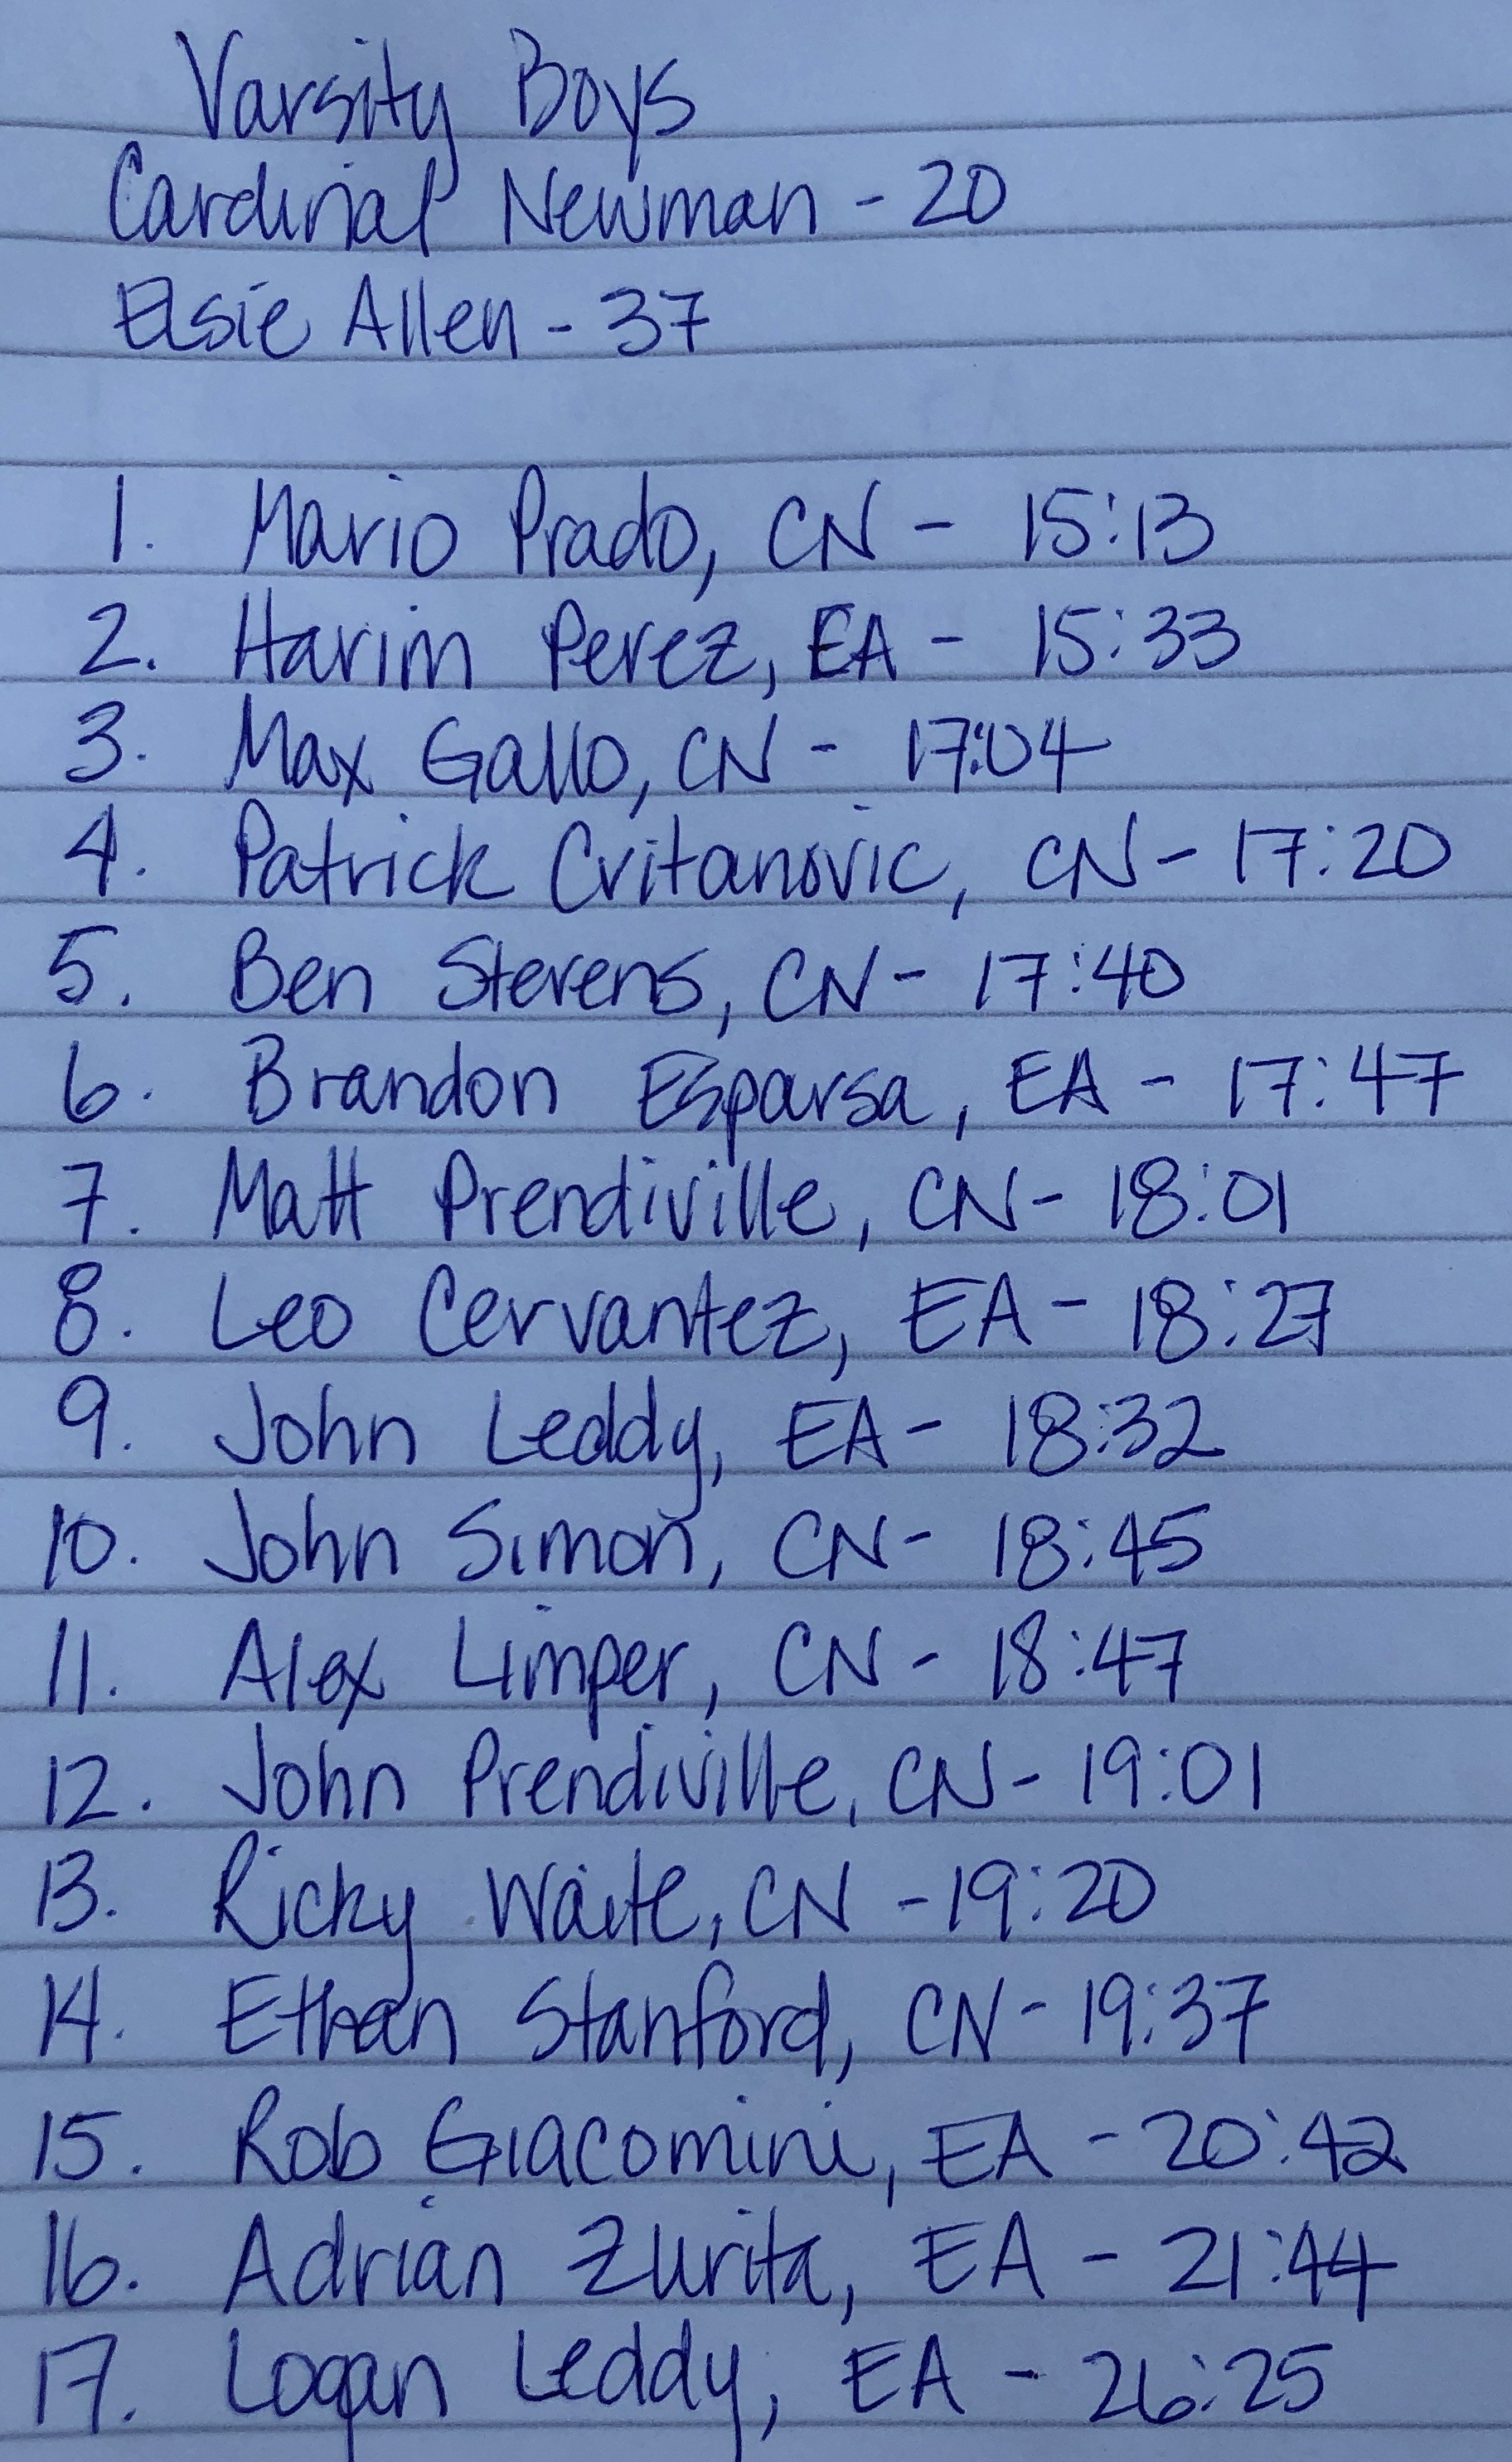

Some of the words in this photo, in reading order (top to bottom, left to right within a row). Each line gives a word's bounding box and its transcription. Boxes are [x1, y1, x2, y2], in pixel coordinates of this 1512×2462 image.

[176, 30, 458, 201] Varsity
[511, 27, 695, 180] Boys
[109, 141, 458, 258] Cardinal
[504, 168, 817, 245] Newman
[913, 160, 1006, 226] 20
[114, 277, 310, 360] Elsie
[344, 274, 517, 360] Allen
[601, 288, 710, 356] 37
[113, 474, 153, 563] 1.
[241, 473, 458, 578] Mario
[510, 464, 715, 601] Prado,
[768, 480, 880, 571] CN
[1025, 487, 1214, 565] 15:13
[80, 603, 156, 676] 2.
[541, 599, 775, 700] Perez,
[807, 603, 897, 681] EA
[1035, 604, 1240, 678] 15:33
[66, 701, 146, 783] 3.
[225, 693, 374, 796] Max
[423, 716, 649, 817] Gallo,
[679, 714, 778, 792] CN
[909, 716, 1112, 793] 17:04
[65, 803, 146, 897] 4.
[235, 798, 515, 905] Patrick
[1027, 812, 1136, 899] CN
[1237, 818, 1451, 888] 17:20
[49, 925, 129, 1006] 5.
[230, 927, 371, 1015] Ben
[763, 945, 880, 1022] CN
[976, 942, 1185, 1011] 17:40
[64, 1040, 152, 1124] 6.
[242, 1034, 557, 1125] Brandon
[1006, 1048, 1109, 1114] EA
[1230, 1043, 1464, 1118] 17:47
[62, 1161, 139, 1244] 7.
[213, 1146, 373, 1241] Matt
[434, 1149, 869, 1252] Prendiville,
[909, 1166, 1018, 1231] CN
[1111, 1156, 1287, 1240] 18:01
[55, 1262, 131, 1356] 8.
[212, 1276, 352, 1352] Leo
[419, 1264, 847, 1381] Cervantez,
[899, 1272, 1032, 1354] EA
[1133, 1277, 1334, 1364] 18:27
[58, 1375, 130, 1459] 9.
[215, 1381, 416, 1465] John
[486, 1375, 722, 1525] Leddy,
[776, 1395, 888, 1471] EA
[1007, 1391, 1225, 1477] 18:32
[44, 1504, 137, 1590] 10.
[204, 1488, 398, 1583] John
[448, 1495, 723, 1589] Simon,
[773, 1510, 888, 1581] CN
[996, 1503, 1210, 1591] 18:45
[49, 1617, 117, 1715] 11.
[220, 1618, 385, 1729] Alex
[454, 1605, 718, 1739] Limper,
[775, 1621, 881, 1697] CN
[993, 1610, 1187, 1703] 18:47
[46, 1755, 150, 1830] 12.
[222, 1723, 405, 1820] John
[463, 1723, 856, 1828] Prendiville,
[889, 1740, 993, 1819] CN
[1083, 1735, 1260, 1810] 19:01
[37, 1849, 116, 1932] 13.
[213, 1830, 414, 2008] Ricky
[487, 1848, 722, 1951] Waite,
[745, 1861, 850, 1939] CN
[949, 1859, 1156, 1942] 19:20
[40, 1965, 123, 2065] 14.
[216, 1973, 457, 2065] Ethan
[516, 1960, 852, 2084] Stanford,
[907, 1977, 1004, 2062] CN
[1083, 1972, 1269, 2064] 19:37
[35, 2111, 141, 2180] 15.
[234, 2085, 381, 2185] Rob
[421, 2096, 894, 2207] Giacomini,
[922, 2111, 1053, 2188] EA
[1141, 2109, 1407, 2183] 20:42
[44, 2210, 138, 2309] 16.
[223, 2195, 503, 2314] Adrian
[567, 2206, 854, 2326] Zurita,
[913, 2211, 1044, 2300] EA
[1161, 2220, 1398, 2322] 21:44
[36, 2334, 135, 2435] 17.
[516, 2319, 778, 2462] Leddy,
[841, 2334, 965, 2414] EA
[1083, 2343, 1332, 2426] 26:25
